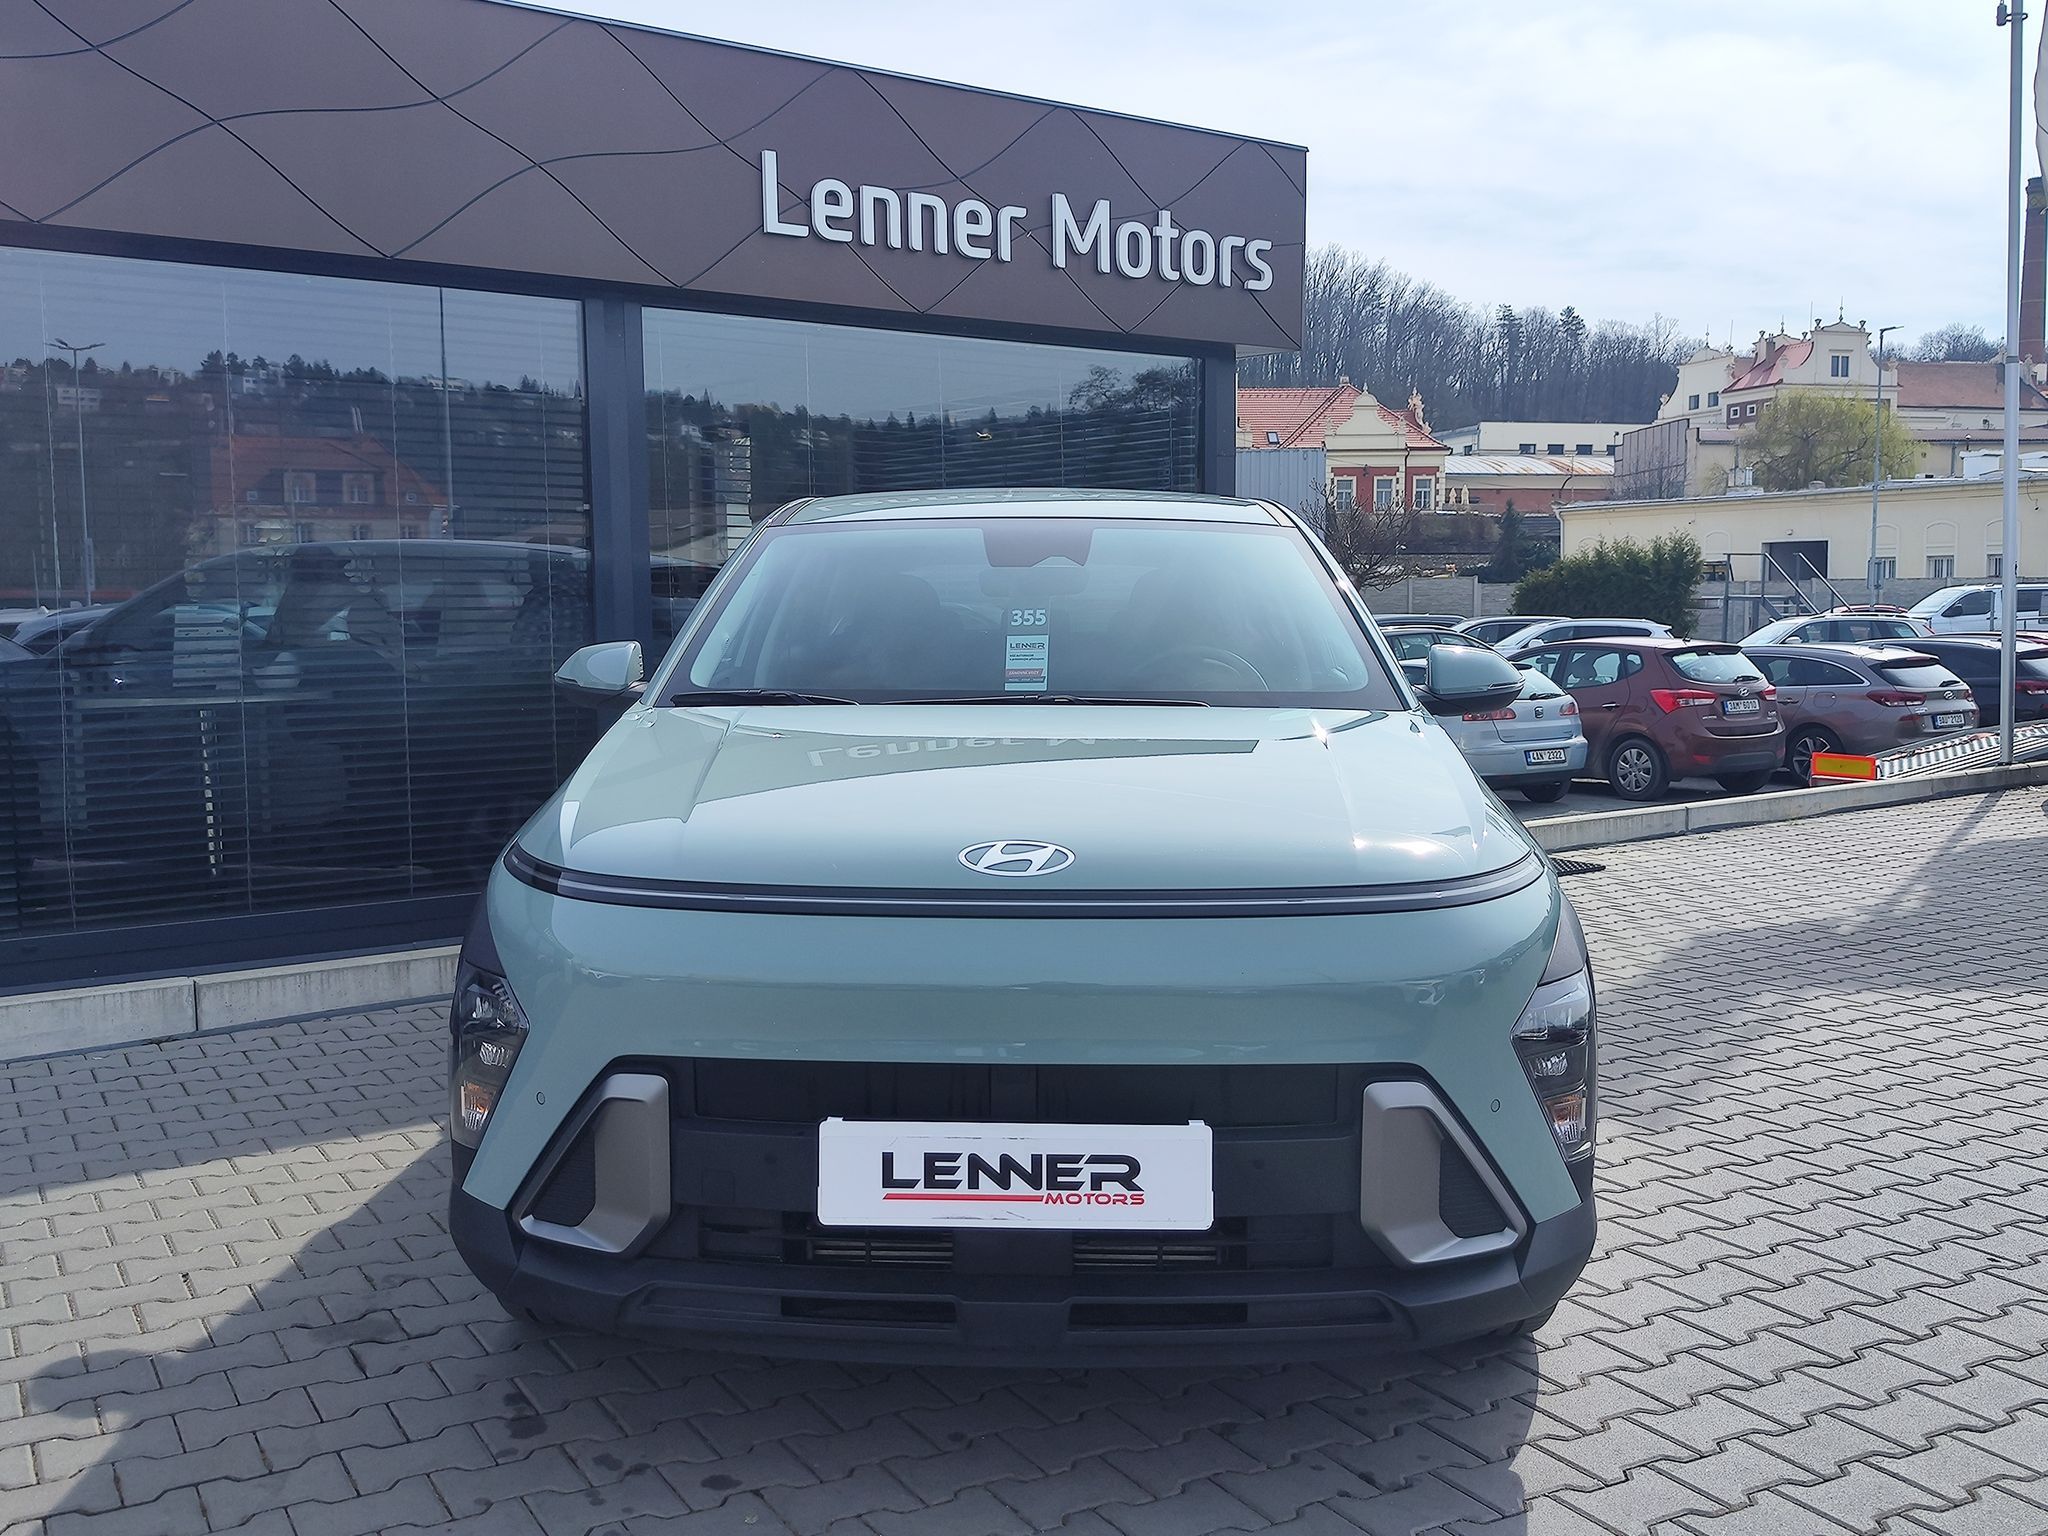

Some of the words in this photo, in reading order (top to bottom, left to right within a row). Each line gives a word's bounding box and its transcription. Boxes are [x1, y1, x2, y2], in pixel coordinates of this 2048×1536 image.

[760, 149, 1028, 263] Lenner
[1051, 192, 1275, 292] Motors
[1010, 609, 1047, 626] 355
[1532, 751, 1544, 760] 4AN
[1546, 750, 1563, 760] 2322
[881, 1151, 1145, 1192] LENNER
[1043, 1193, 1145, 1206] MOTORS
